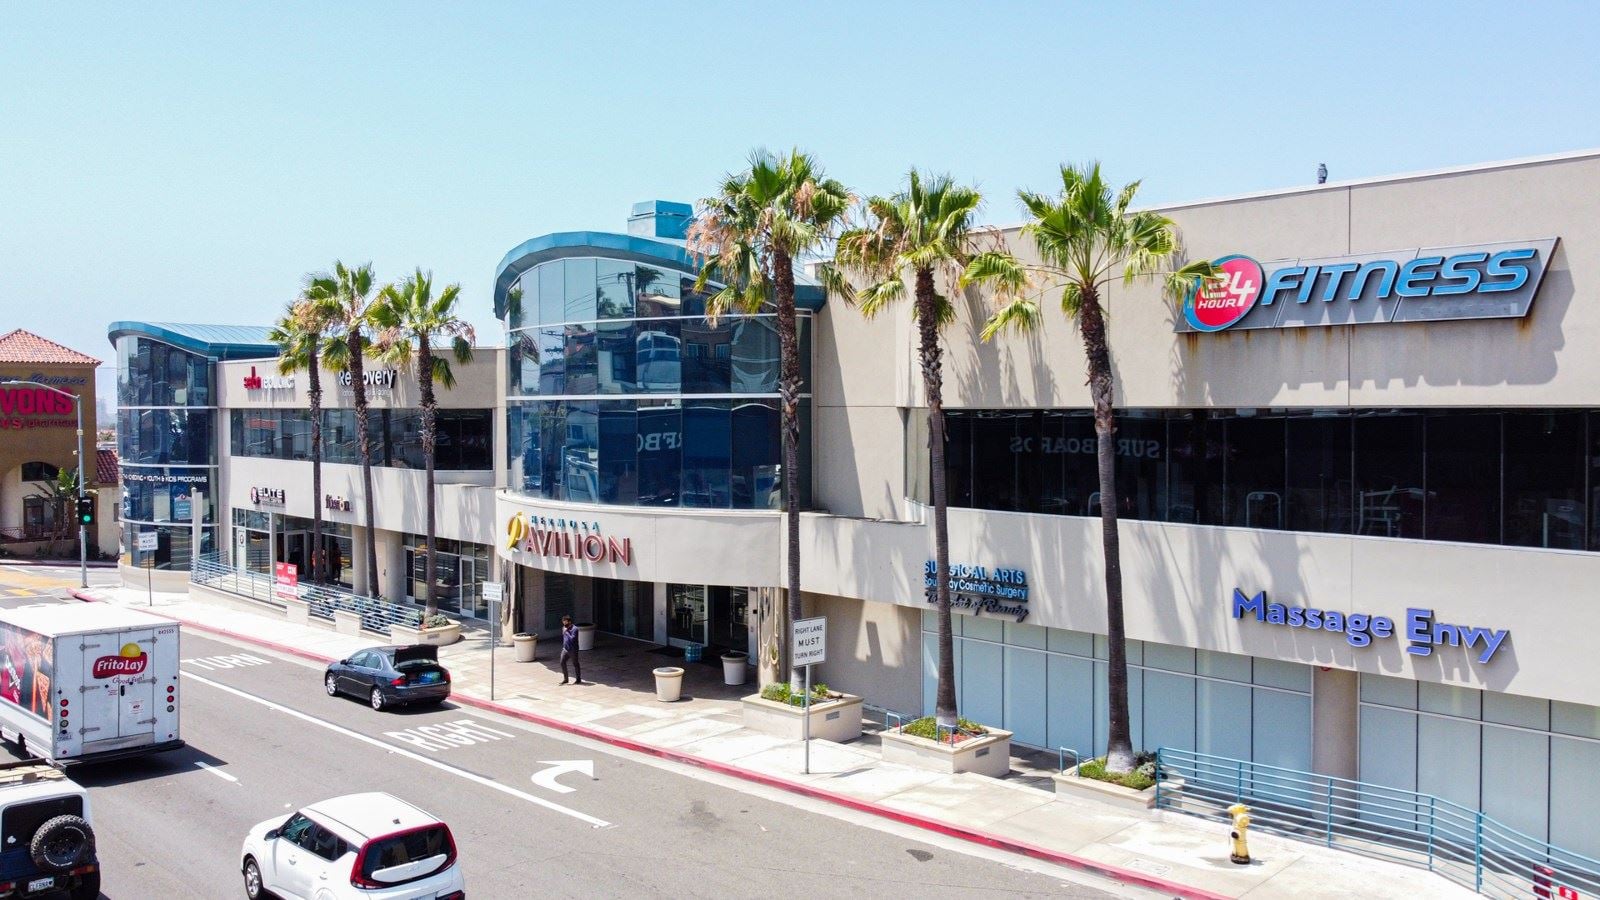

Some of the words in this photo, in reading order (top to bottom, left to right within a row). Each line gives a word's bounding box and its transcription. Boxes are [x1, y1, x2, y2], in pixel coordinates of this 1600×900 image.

[1260, 247, 1538, 306] FITNESS
[1202, 271, 1256, 307] 24
[1198, 297, 1237, 310] HOUR
[338, 369, 394, 388] Reovery
[0, 387, 73, 416] VONS
[257, 487, 283, 498] ELITE
[531, 515, 600, 530] HERMOSA
[924, 560, 988, 580] SUGICAL
[992, 567, 1025, 584] ARTS
[959, 578, 995, 594] Cosmetic
[996, 584, 1026, 599] Surgery
[795, 627, 809, 635] RIGHT
[810, 624, 823, 632] LANE
[1231, 587, 1395, 649] Massage
[1405, 607, 1510, 664] Envy
[798, 636, 820, 647] MUST
[181, 653, 273, 671] TURN
[809, 648, 823, 657] RIGHT
[382, 719, 516, 752] RIGHT
